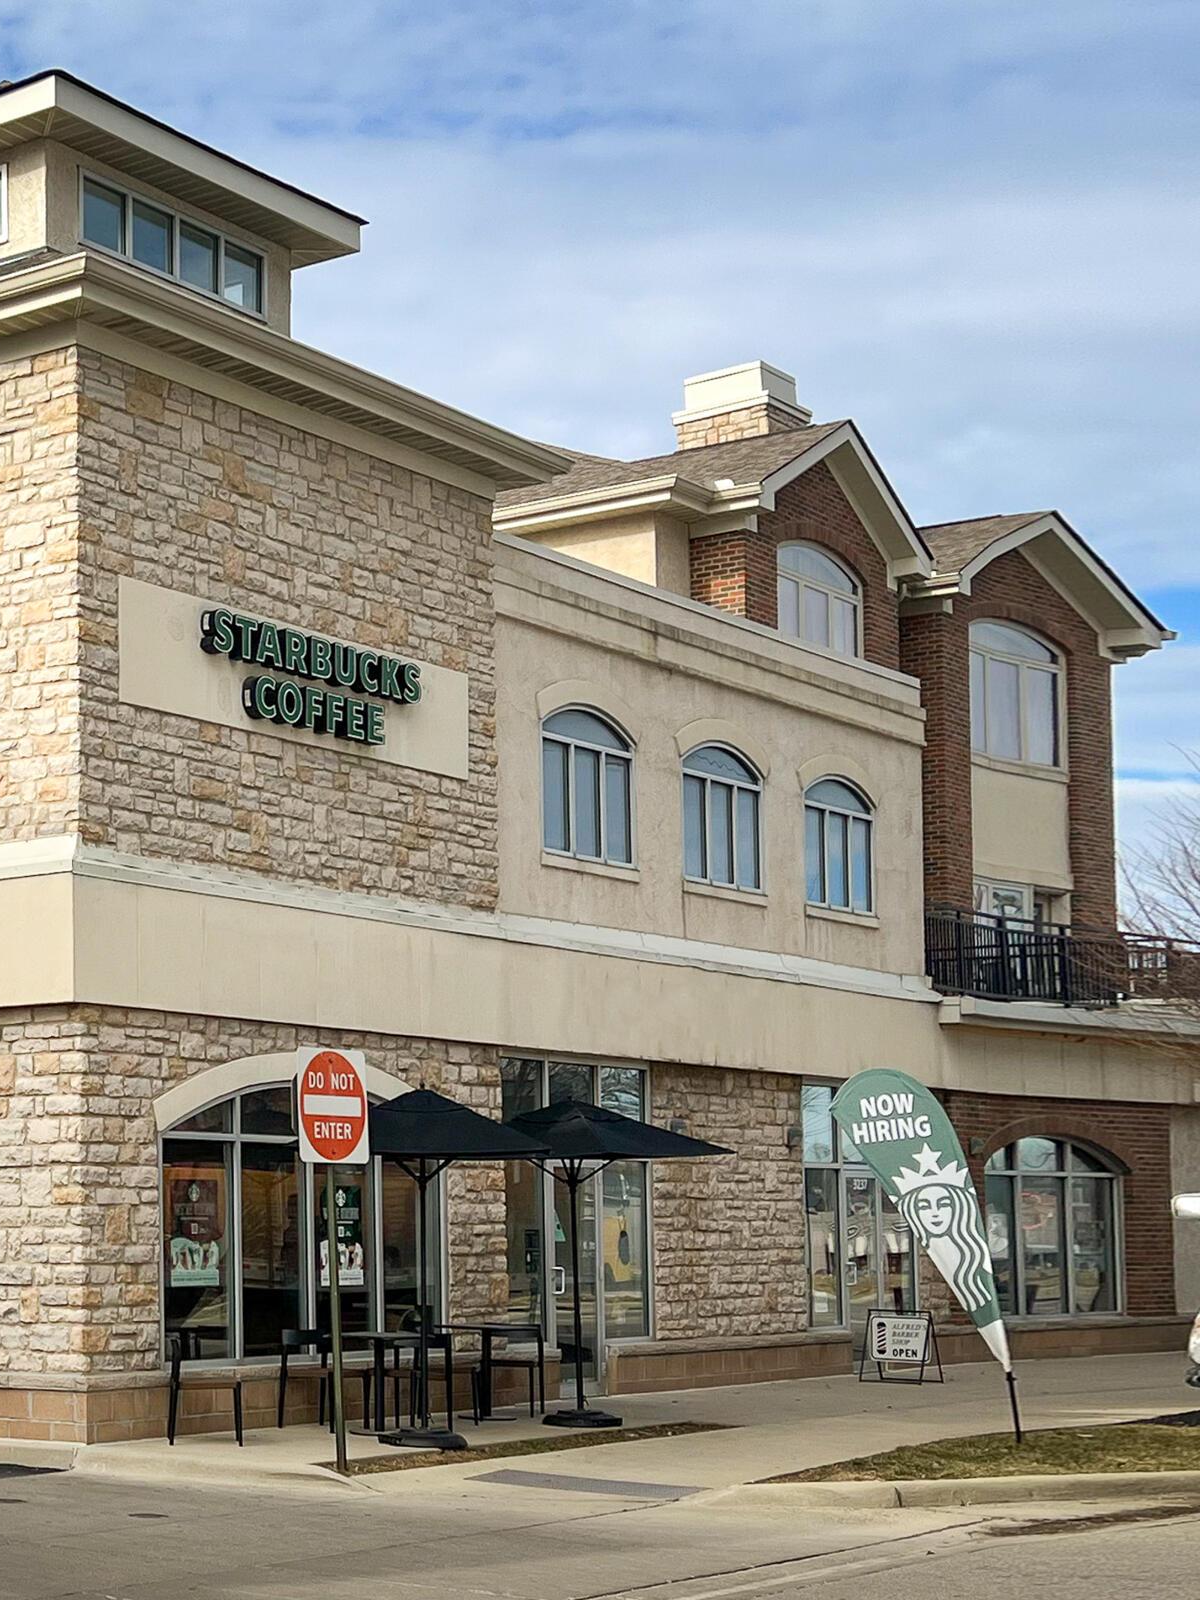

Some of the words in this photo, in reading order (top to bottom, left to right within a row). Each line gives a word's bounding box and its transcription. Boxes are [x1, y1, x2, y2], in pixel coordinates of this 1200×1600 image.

[210, 608, 422, 704] STARBUCKS
[254, 675, 386, 745] COFFEE
[308, 1071, 325, 1089] DO
[331, 1073, 355, 1091] NOT
[859, 1093, 914, 1119] NOW
[313, 1121, 352, 1140] ENTER
[852, 1115, 932, 1145] HIRING
[892, 1323, 927, 1331] ALFRED'S
[892, 1349, 918, 1358] OPEN
